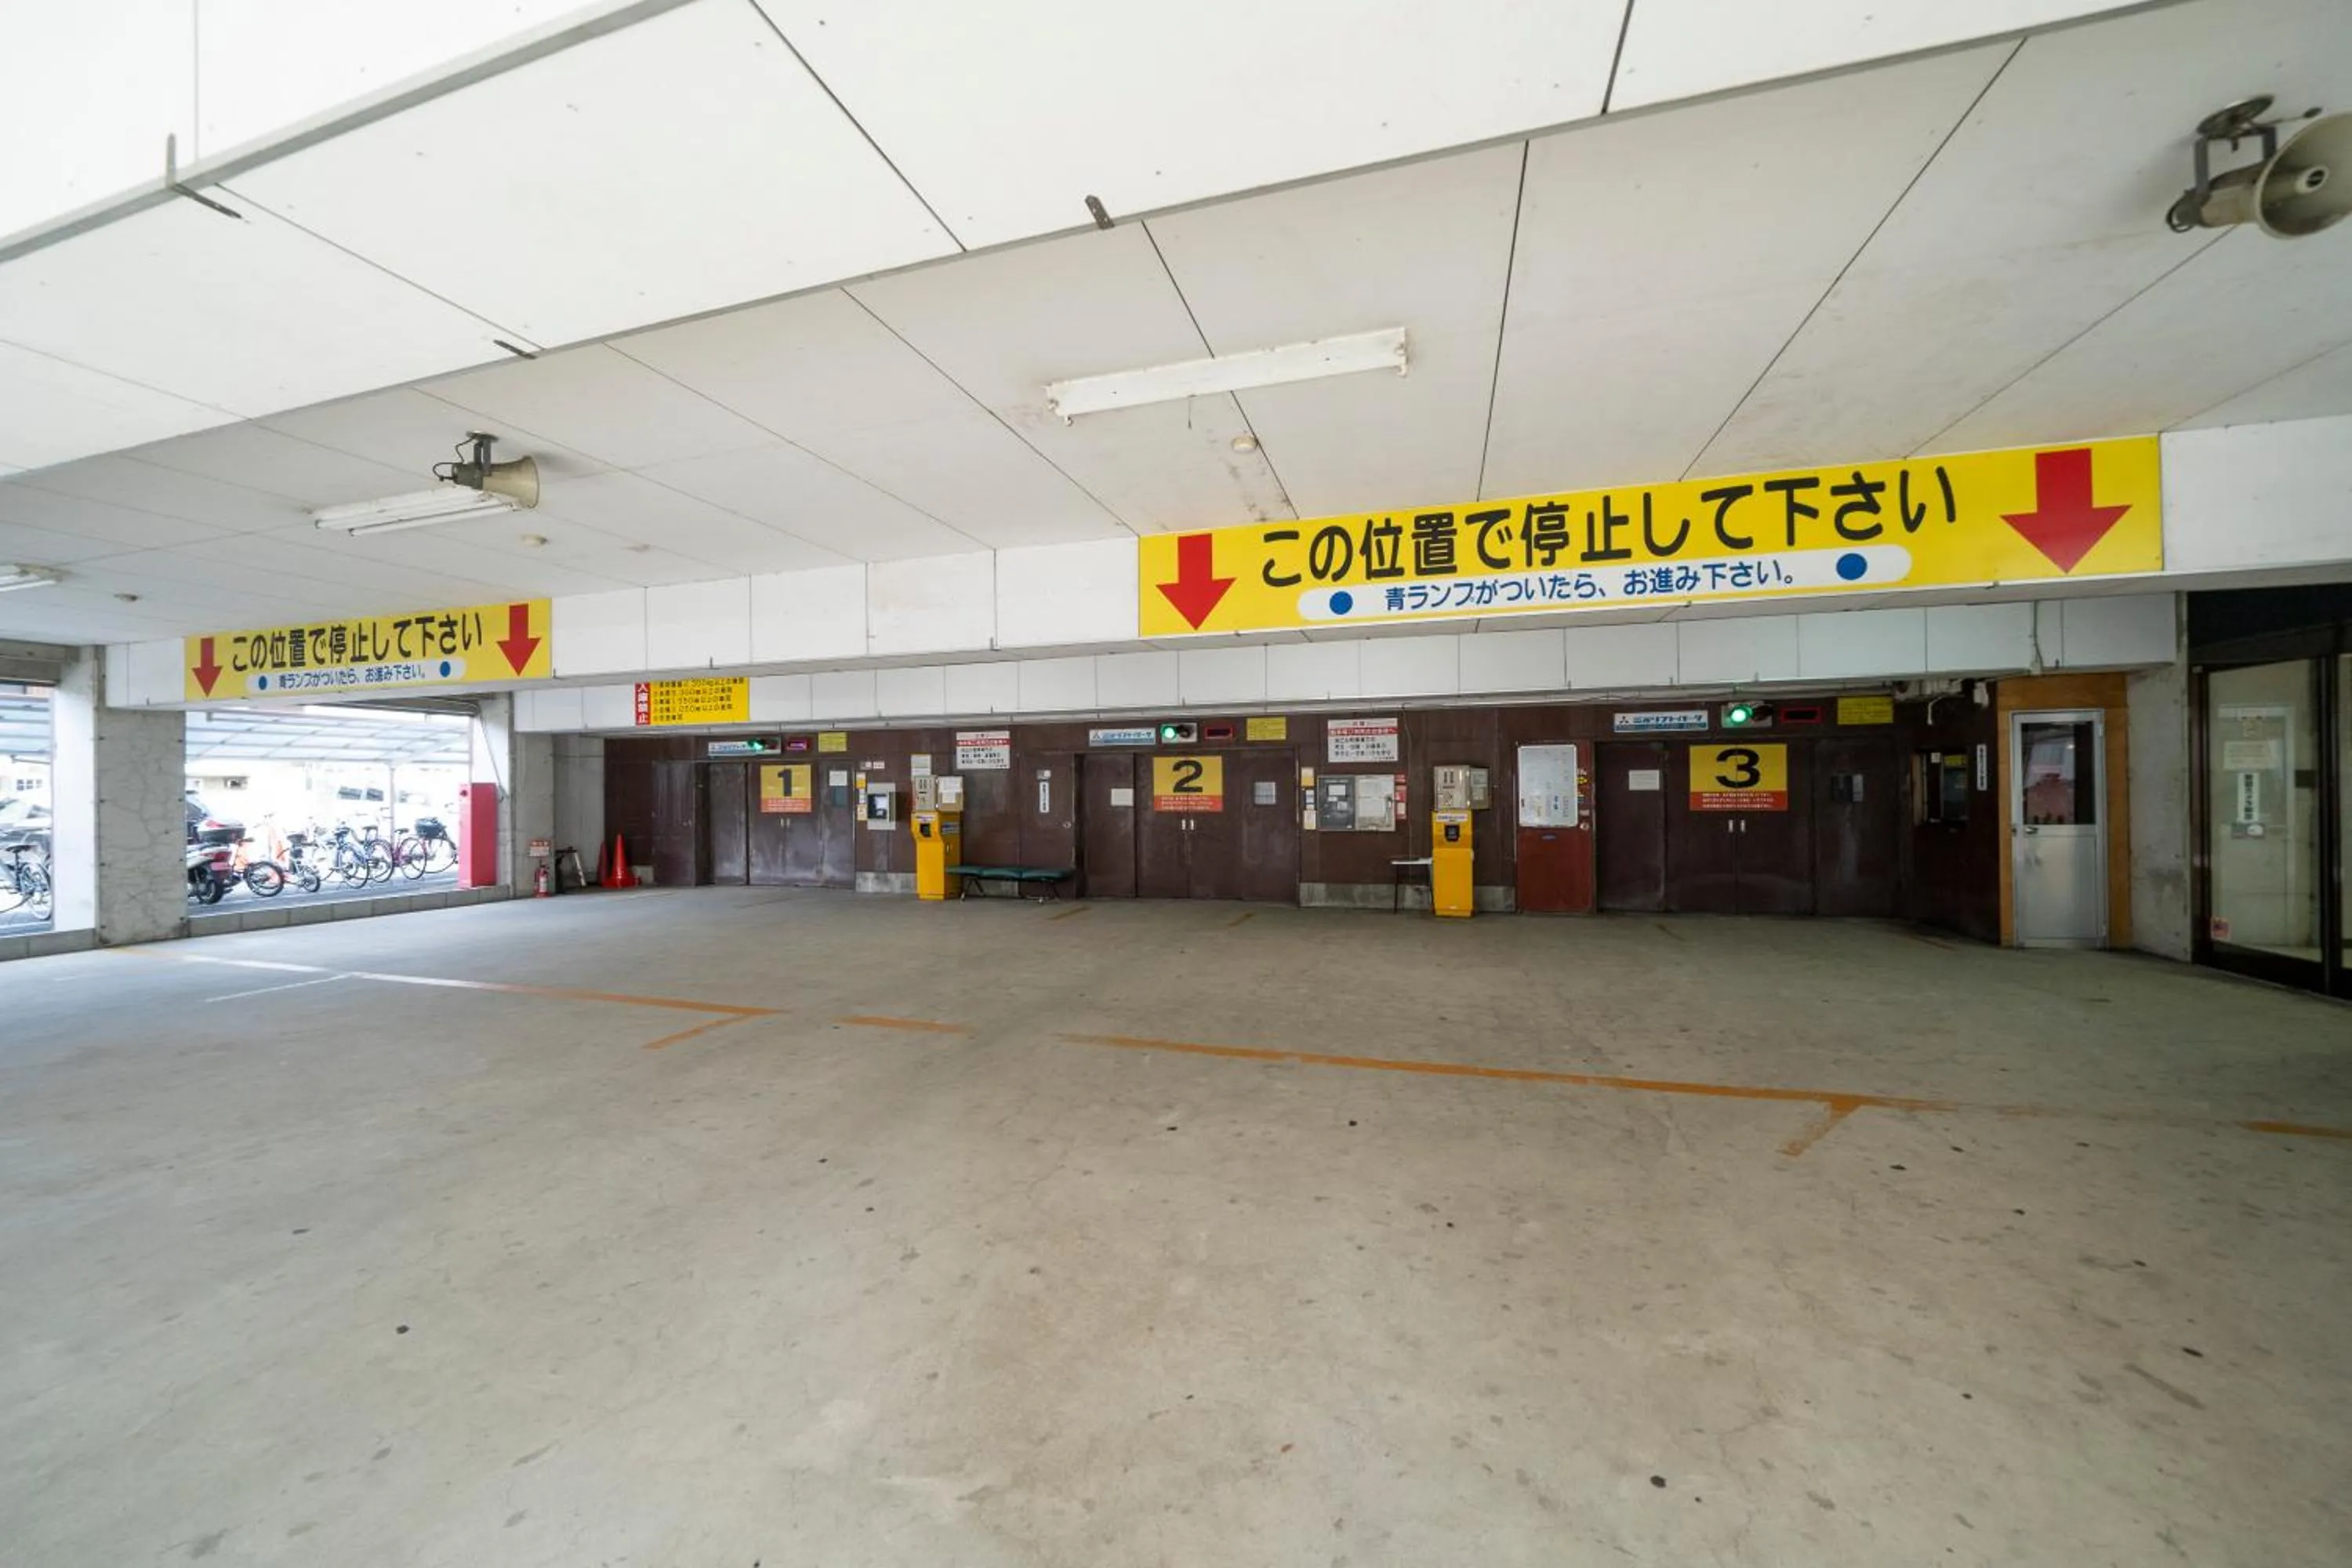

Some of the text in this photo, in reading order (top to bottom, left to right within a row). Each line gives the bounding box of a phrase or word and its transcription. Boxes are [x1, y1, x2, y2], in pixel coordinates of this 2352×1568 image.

[1262, 466, 1956, 588] この位置で停止して下さい
[232, 612, 482, 672] この位置で停止して下さい
[777, 768, 793, 797] 1
[1172, 760, 1203, 793] 2
[1715, 748, 1761, 789] 3
